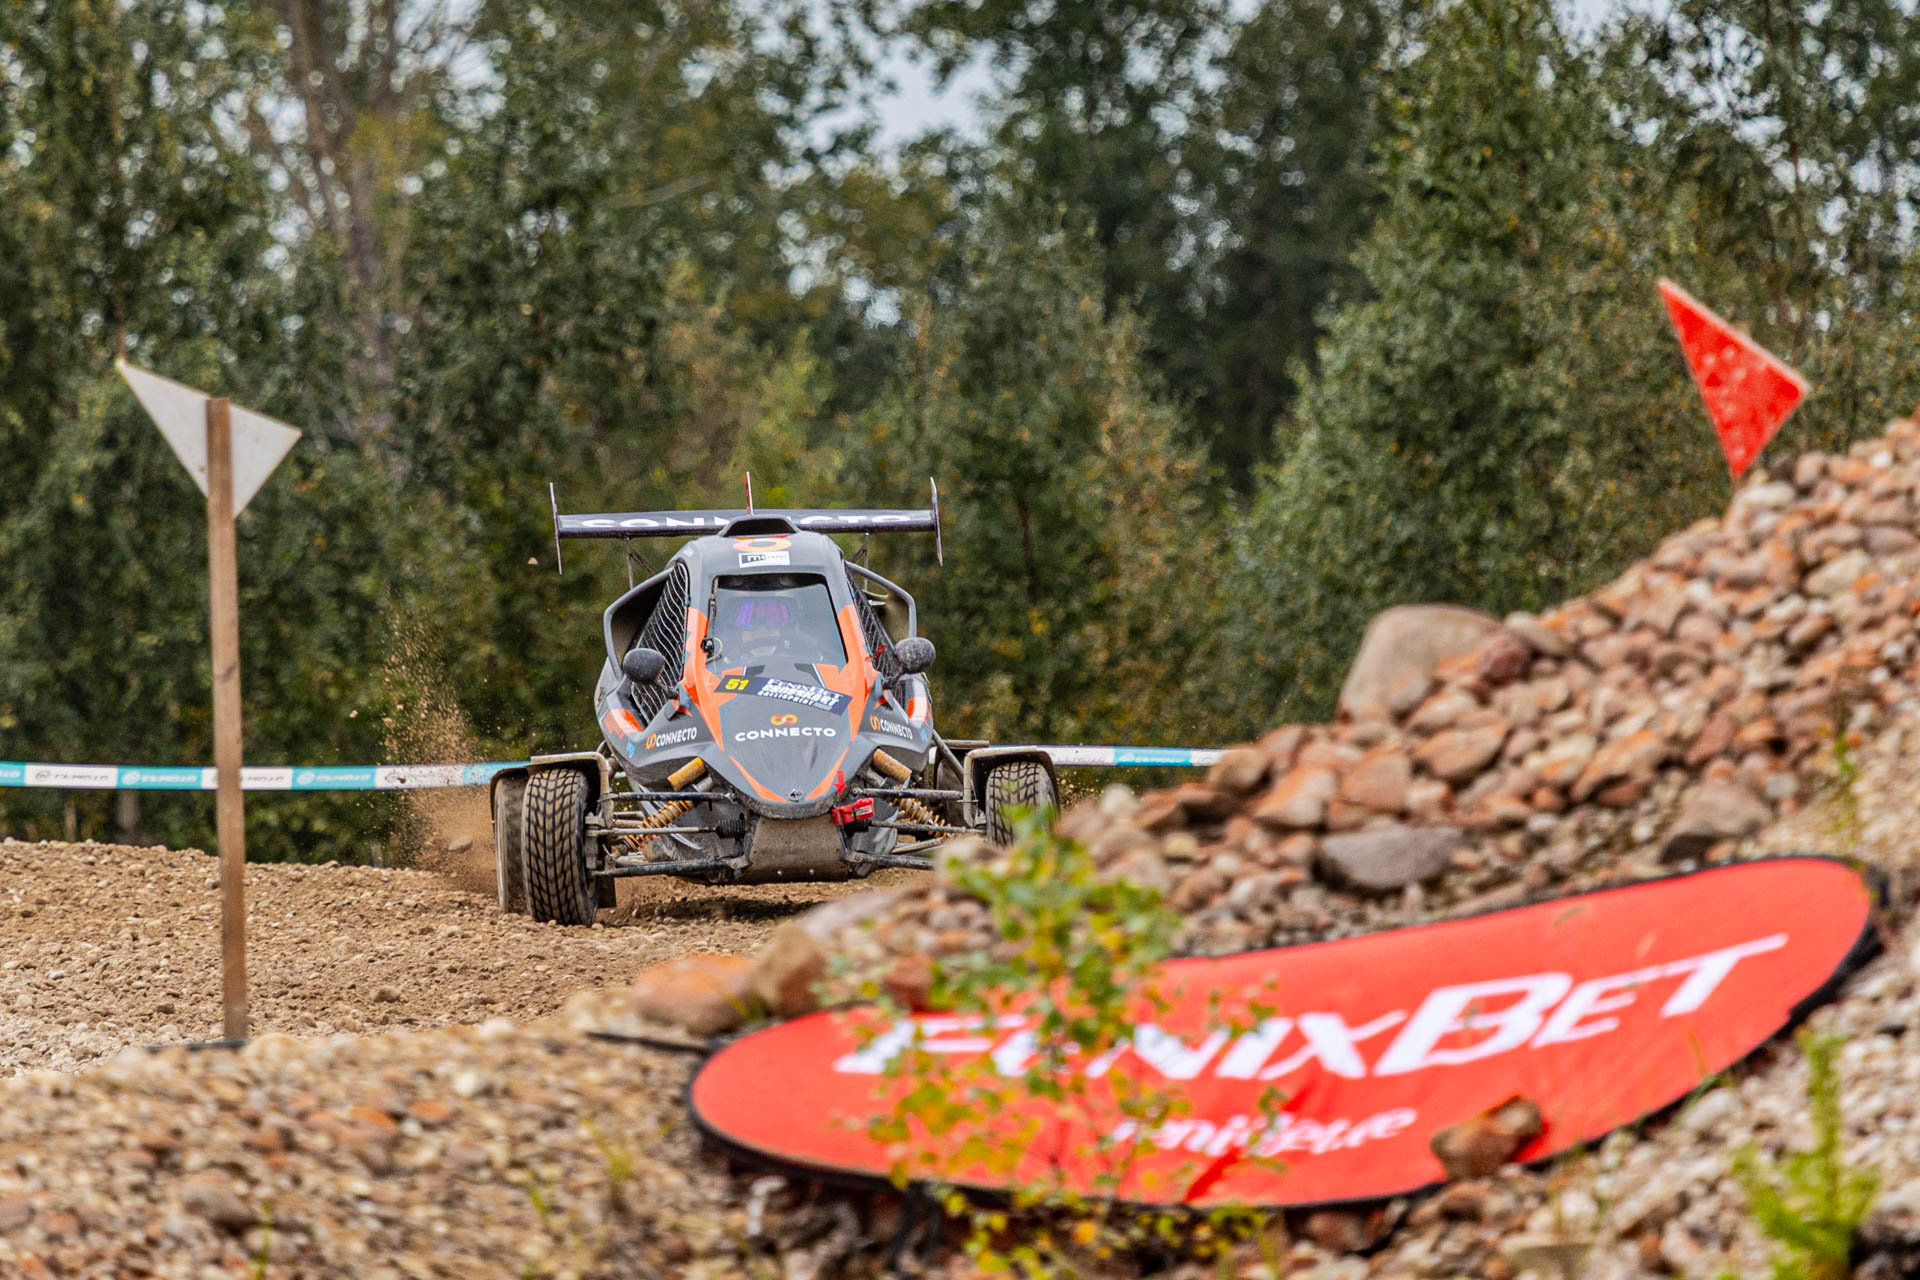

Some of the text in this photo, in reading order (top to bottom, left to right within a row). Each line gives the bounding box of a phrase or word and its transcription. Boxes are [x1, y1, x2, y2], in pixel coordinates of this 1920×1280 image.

[581, 515, 912, 528] CONCTO
[725, 678, 749, 691] 51
[735, 727, 837, 742] CONNECTO
[880, 718, 913, 740] CONNECTO
[656, 726, 698, 748] CONNECTO
